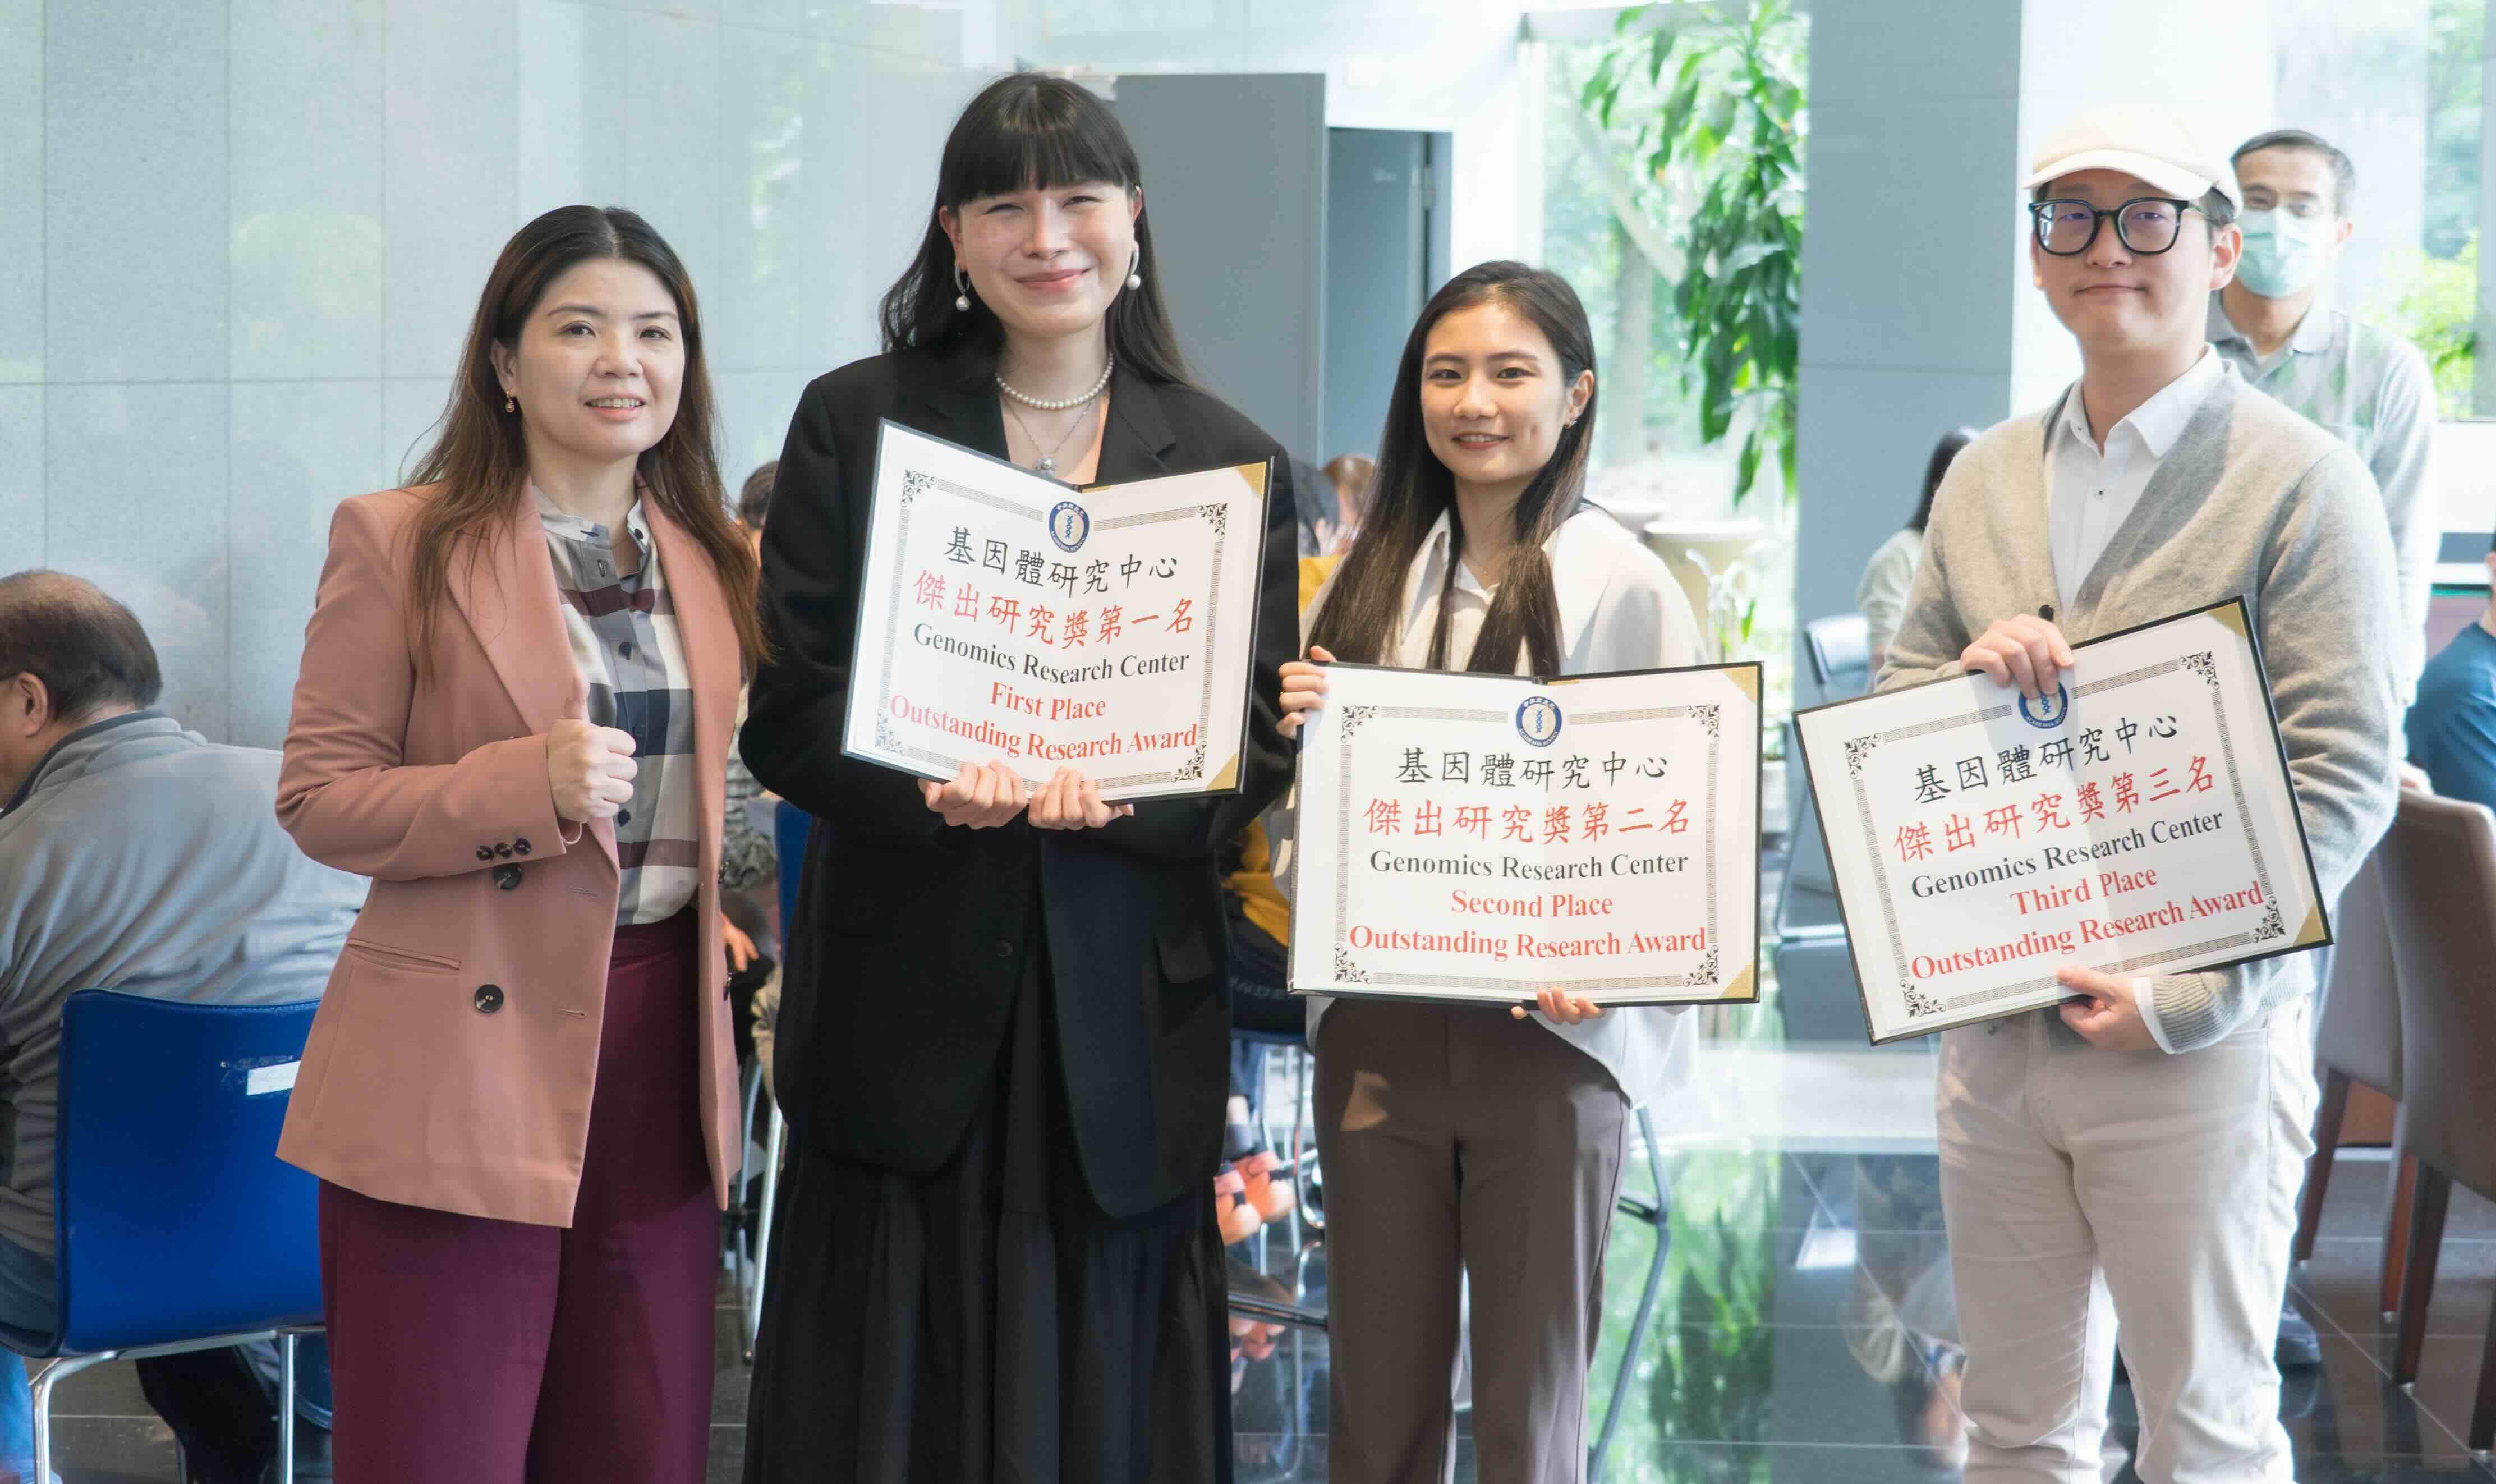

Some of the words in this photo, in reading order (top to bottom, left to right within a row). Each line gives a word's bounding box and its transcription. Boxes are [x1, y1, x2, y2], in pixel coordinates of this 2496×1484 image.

[945, 526, 1177, 597] 基因體研究中心
[914, 570, 1193, 650] 傑出研究獎第一名
[914, 623, 1015, 671] Genomics
[1023, 654, 1113, 684] Research
[1120, 654, 1190, 677] Center
[891, 695, 1021, 757] Outstanding
[1028, 732, 1122, 761] Research
[1129, 724, 1196, 752] Award
[991, 682, 1042, 716] First
[1050, 699, 1106, 721] Place
[1395, 747, 1667, 791] 基因體研究中心
[1914, 715, 2177, 804] 基因體研究中心
[1363, 798, 1689, 844] 傑出研究獎第二名
[1894, 755, 2214, 862] 傑出研究獎第三名
[1371, 851, 1492, 876] Genomics
[1503, 857, 1602, 880] Research
[1611, 854, 1688, 875] Center
[1912, 858, 2037, 898] Genomics
[2044, 829, 2145, 870] Research
[2151, 812, 2222, 843] Center
[1451, 890, 1543, 917] Second
[1551, 894, 1613, 916] Place
[2011, 877, 2092, 916] Third
[2100, 869, 2157, 898] Place
[1350, 926, 1508, 960] Outstanding
[1516, 933, 1621, 958] Research
[1628, 928, 1706, 954] Award
[1912, 930, 2076, 979] Outstanding
[2080, 902, 2184, 944] Research
[2190, 882, 2264, 918] Award
